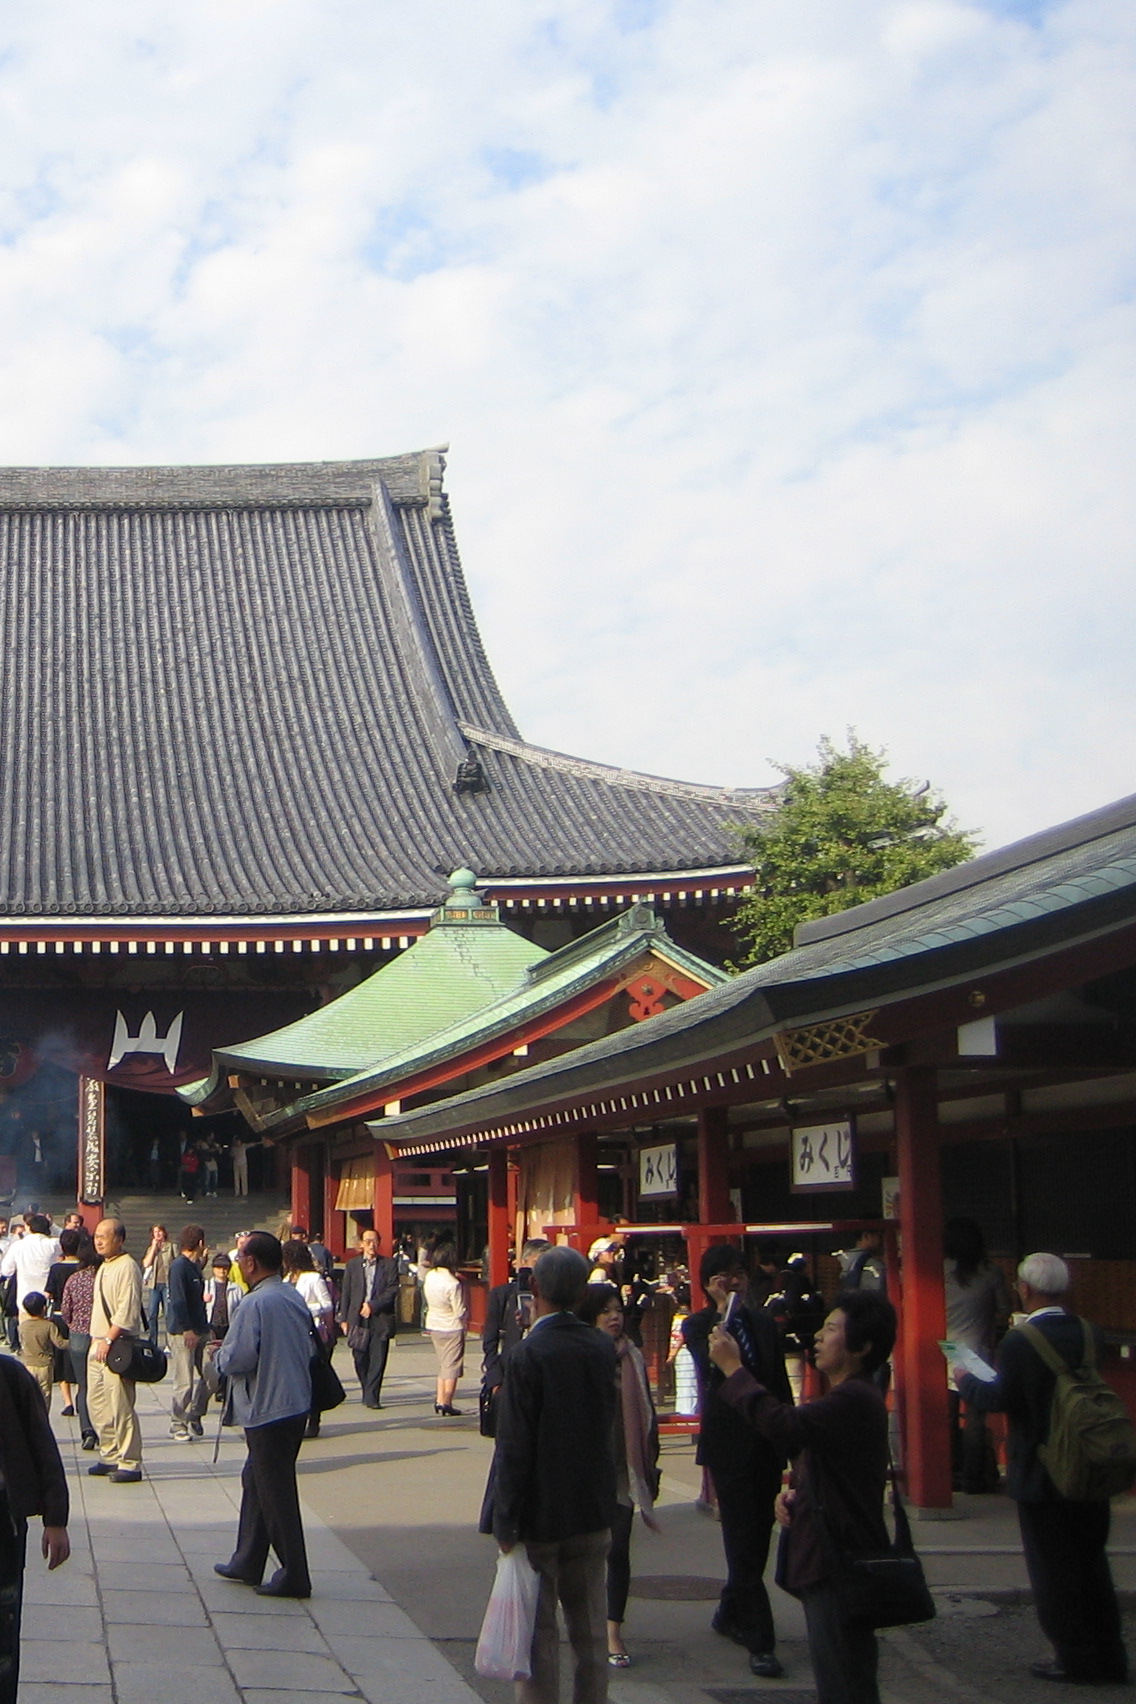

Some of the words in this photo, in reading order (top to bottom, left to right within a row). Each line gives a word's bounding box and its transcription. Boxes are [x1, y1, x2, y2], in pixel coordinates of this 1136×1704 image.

[645, 1150, 676, 1185] みくじ
[800, 1130, 851, 1174] みくじ
